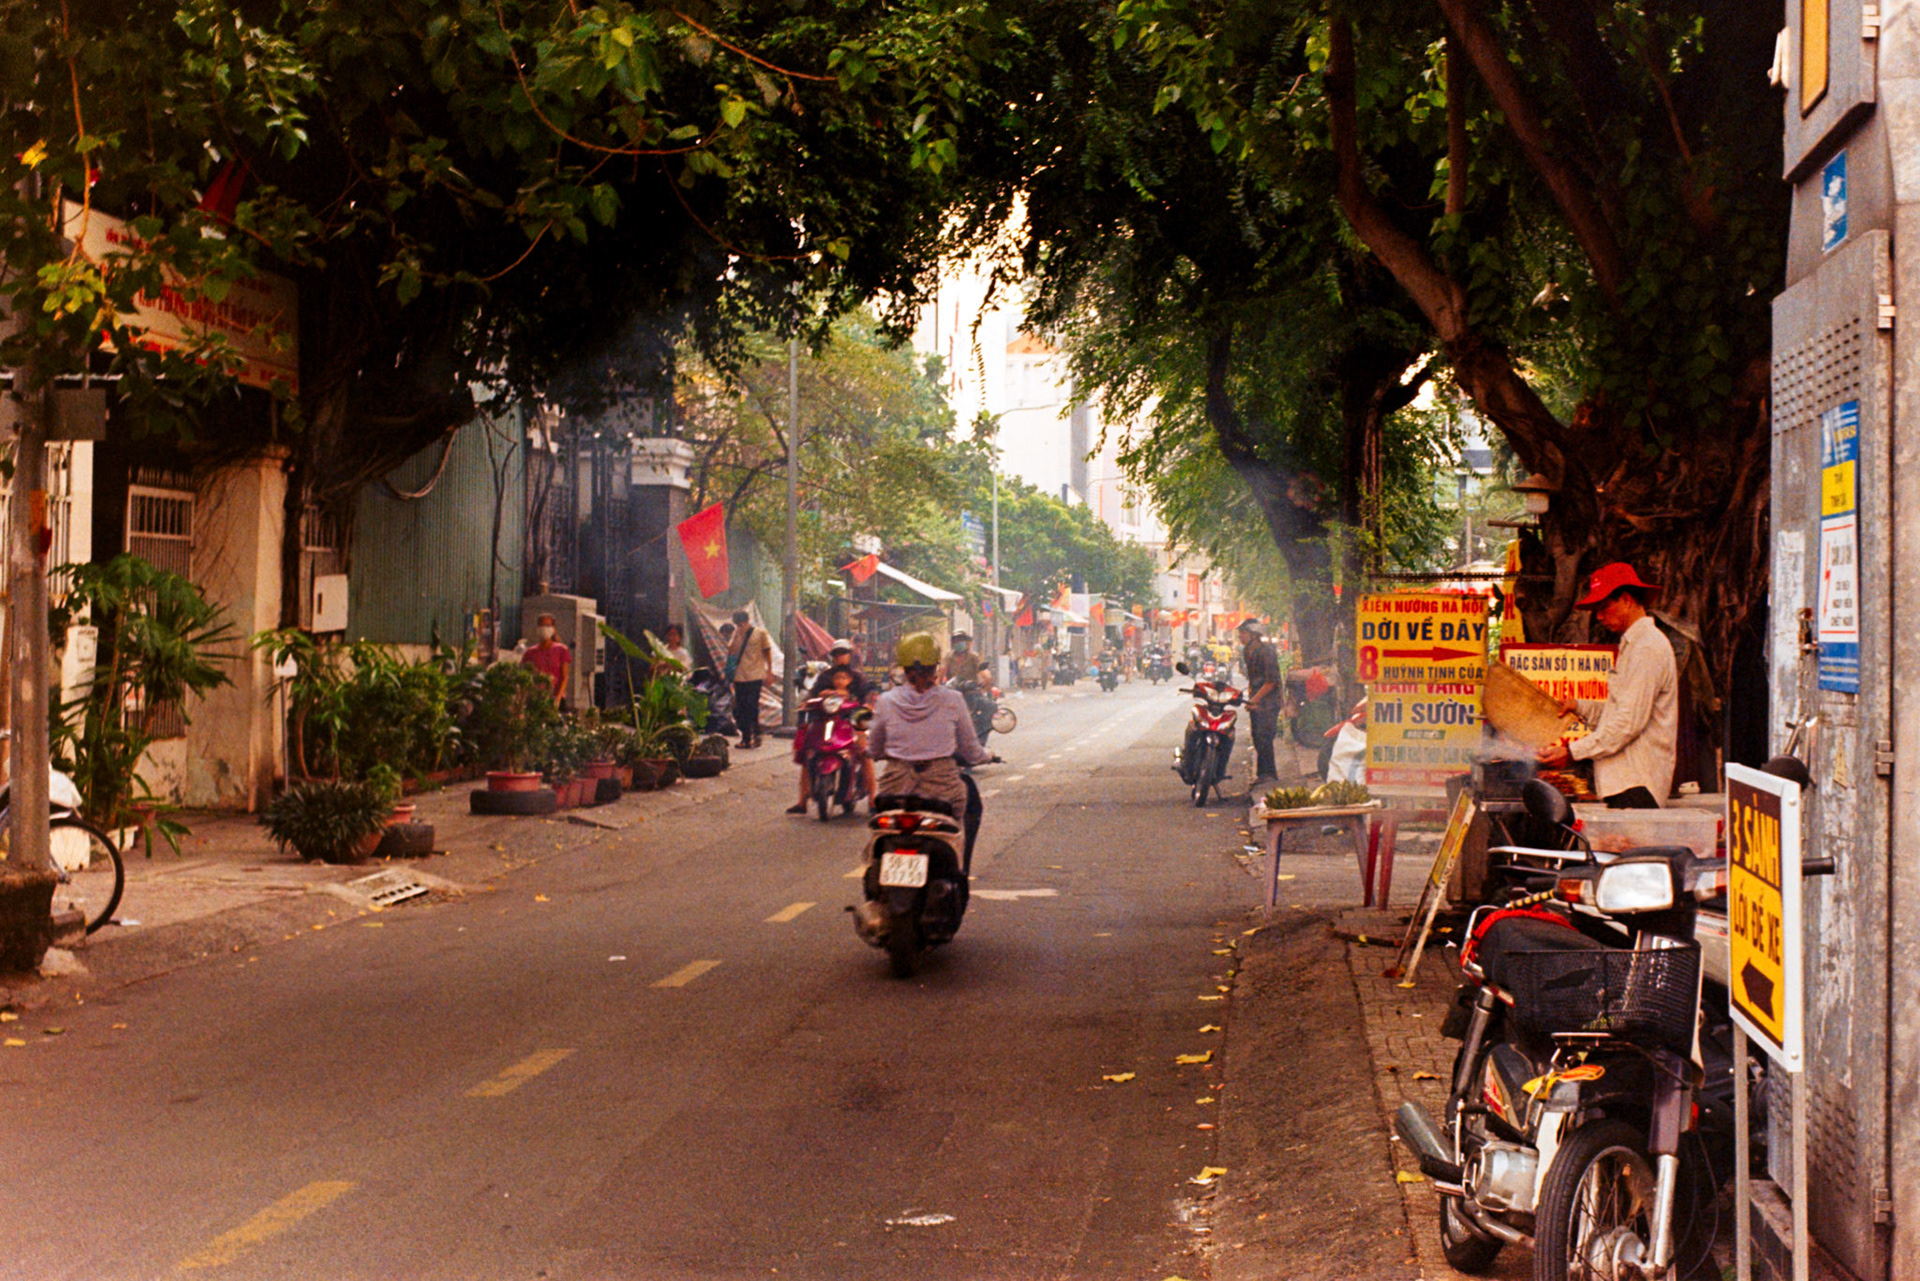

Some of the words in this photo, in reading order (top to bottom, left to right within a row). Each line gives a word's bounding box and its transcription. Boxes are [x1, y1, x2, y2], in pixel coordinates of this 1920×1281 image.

[1362, 617, 1399, 640] DỜI
[1407, 616, 1433, 640] VỀ
[1441, 618, 1484, 641] ĐÂY
[1360, 645, 1379, 681] 8
[1570, 658, 1575, 671] 1
[1374, 698, 1403, 724] MÌ
[1411, 698, 1475, 725] SƯỜN
[1733, 799, 1741, 862] 3
[1768, 911, 1780, 966] XE
